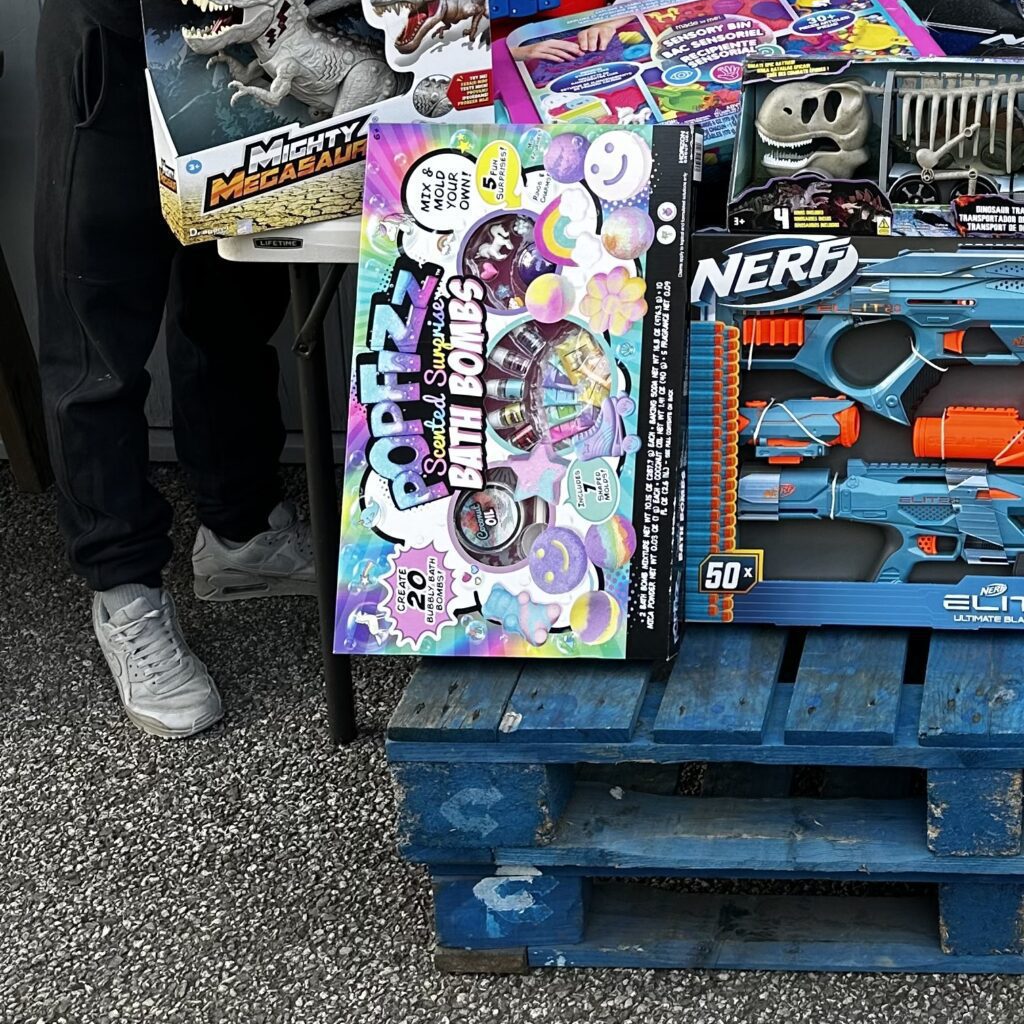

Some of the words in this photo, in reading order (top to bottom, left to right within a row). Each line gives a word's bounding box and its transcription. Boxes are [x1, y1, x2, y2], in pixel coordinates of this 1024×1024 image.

[662, 25, 724, 48] SENSORY
[727, 20, 753, 31] BIN
[806, 13, 836, 25] 30+
[662, 45, 688, 59] BAC
[692, 29, 764, 49] SENSORIEL
[681, 39, 758, 64] RECIPIENTE
[688, 46, 759, 69] SENSORIAL
[248, 122, 362, 174] MIGHTY
[434, 170, 446, 211] MOLD
[446, 172, 457, 209] YOUR
[460, 171, 471, 210] OWN!
[496, 147, 507, 201] SURPRISES!
[420, 183, 431, 212] MIX
[975, 205, 1010, 215] DINOSAUR
[733, 217, 746, 226] 3+
[773, 207, 790, 229] 4
[959, 213, 1018, 223] TRANSPORTADOR
[967, 222, 1008, 232] TRANSPORT
[259, 239, 298, 247] LIFETIME
[690, 233, 859, 309] NERF
[423, 299, 454, 387] Surprise
[448, 277, 485, 397] BOMBS
[360, 269, 450, 510] POPFIZZ
[423, 393, 447, 476] Scented
[448, 405, 484, 489] BATH
[575, 470, 583, 509] INCLUDES
[594, 471, 602, 502] SHAPED
[603, 468, 611, 503] MOLDS!
[426, 557, 436, 582] BATH
[398, 568, 406, 613] CREATE
[407, 569, 426, 612] 20
[426, 586, 436, 624] BUBBLY
[435, 570, 444, 612] BOMBS!
[979, 582, 1008, 597] NERF
[953, 614, 1000, 625] ULTIMATE
